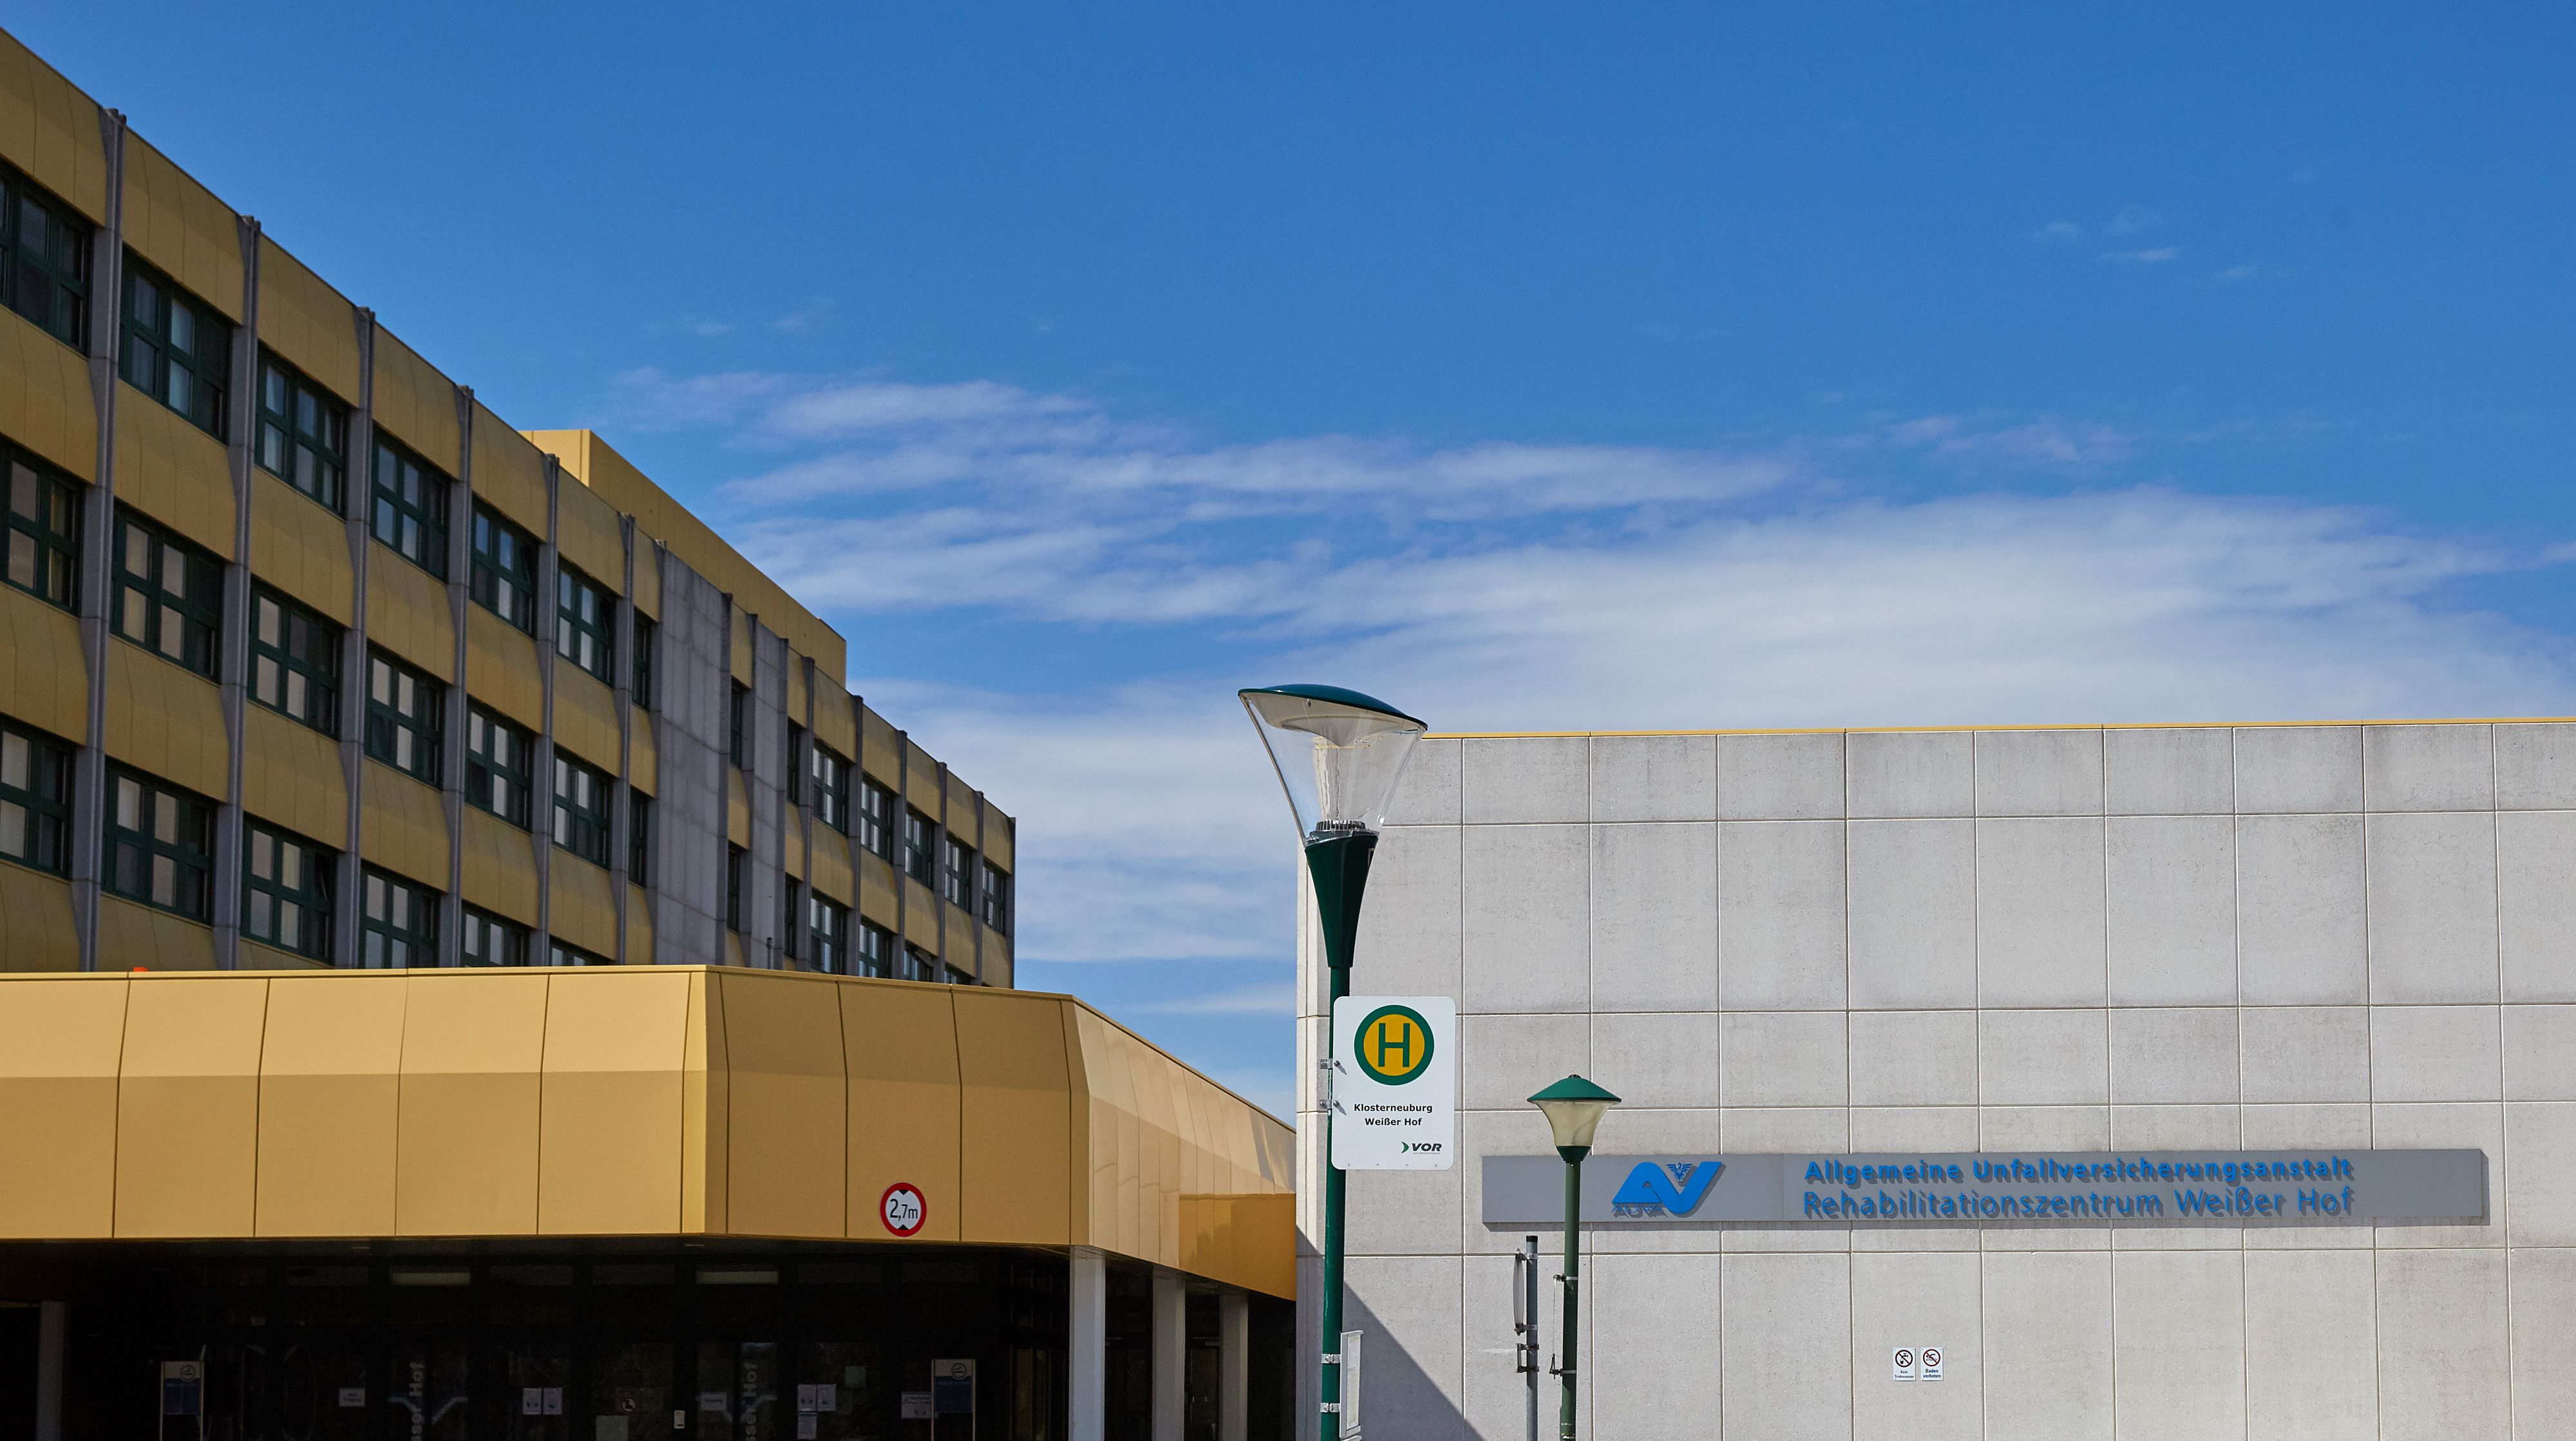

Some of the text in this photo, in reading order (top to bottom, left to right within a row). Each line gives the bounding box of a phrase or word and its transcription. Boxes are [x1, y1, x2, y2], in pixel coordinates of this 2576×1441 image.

[1378, 1022, 1410, 1068] H
[1354, 1103, 1433, 1114] Klosterneuburg
[1365, 1118, 1422, 1126] Weißer Hof
[1412, 1143, 1442, 1152] VOR
[1804, 1156, 2351, 1185] Allgemeine Unfallversicherungsanstalt
[1804, 1185, 2351, 1215] Rehabilitationszentrum Weißer Hof
